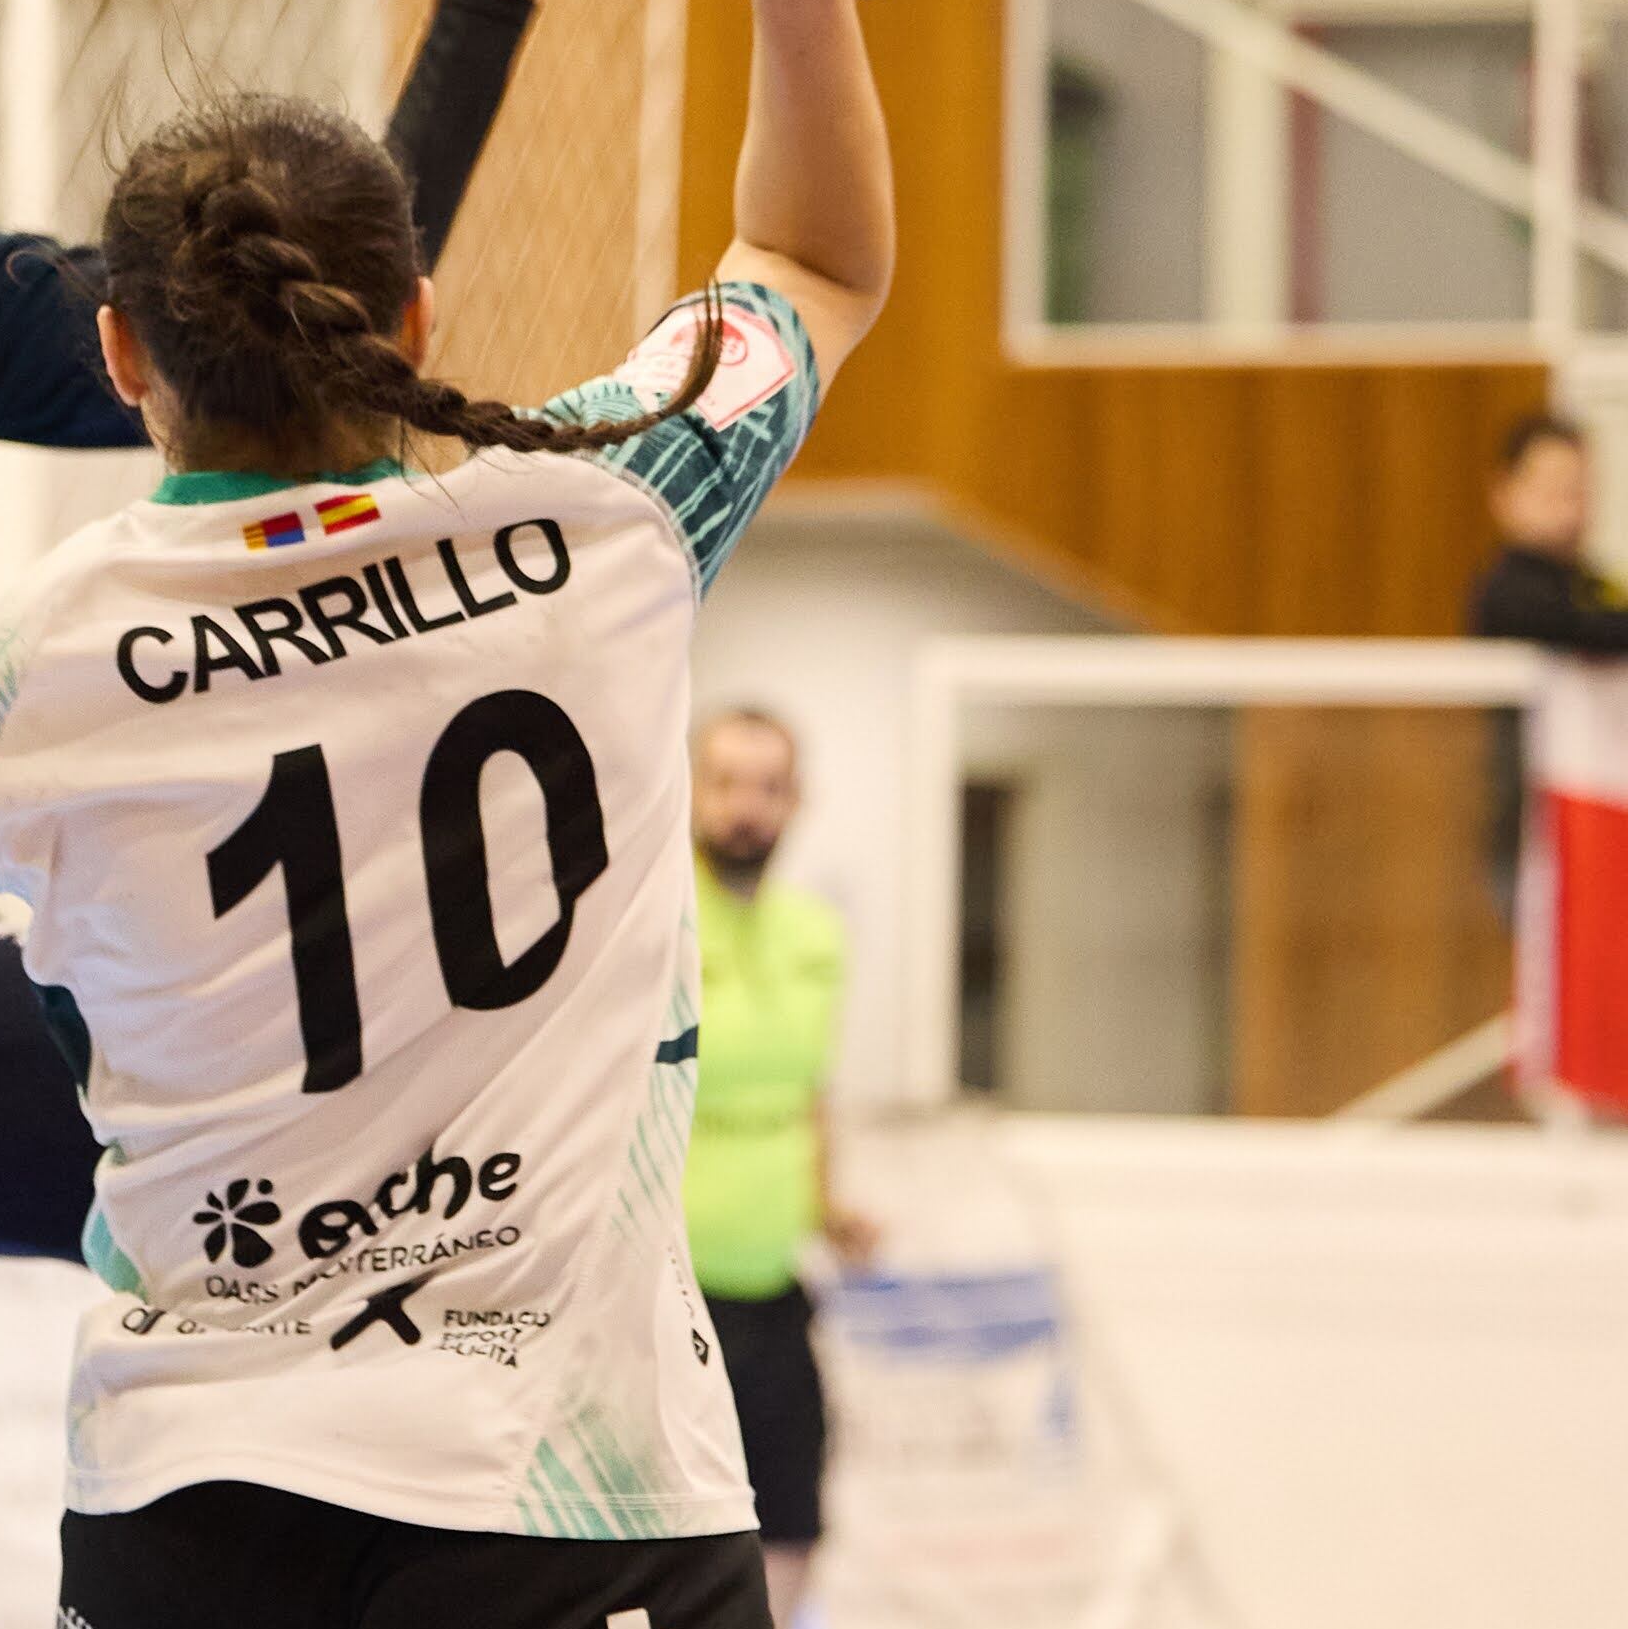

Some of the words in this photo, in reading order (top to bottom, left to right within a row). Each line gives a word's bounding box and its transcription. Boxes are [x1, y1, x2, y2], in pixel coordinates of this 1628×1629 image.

[116, 518, 572, 705] CARRILLO
[206, 689, 609, 1094] 10
[293, 1227, 521, 1296] MTERRÁNEO
[298, 1147, 521, 1260] eche
